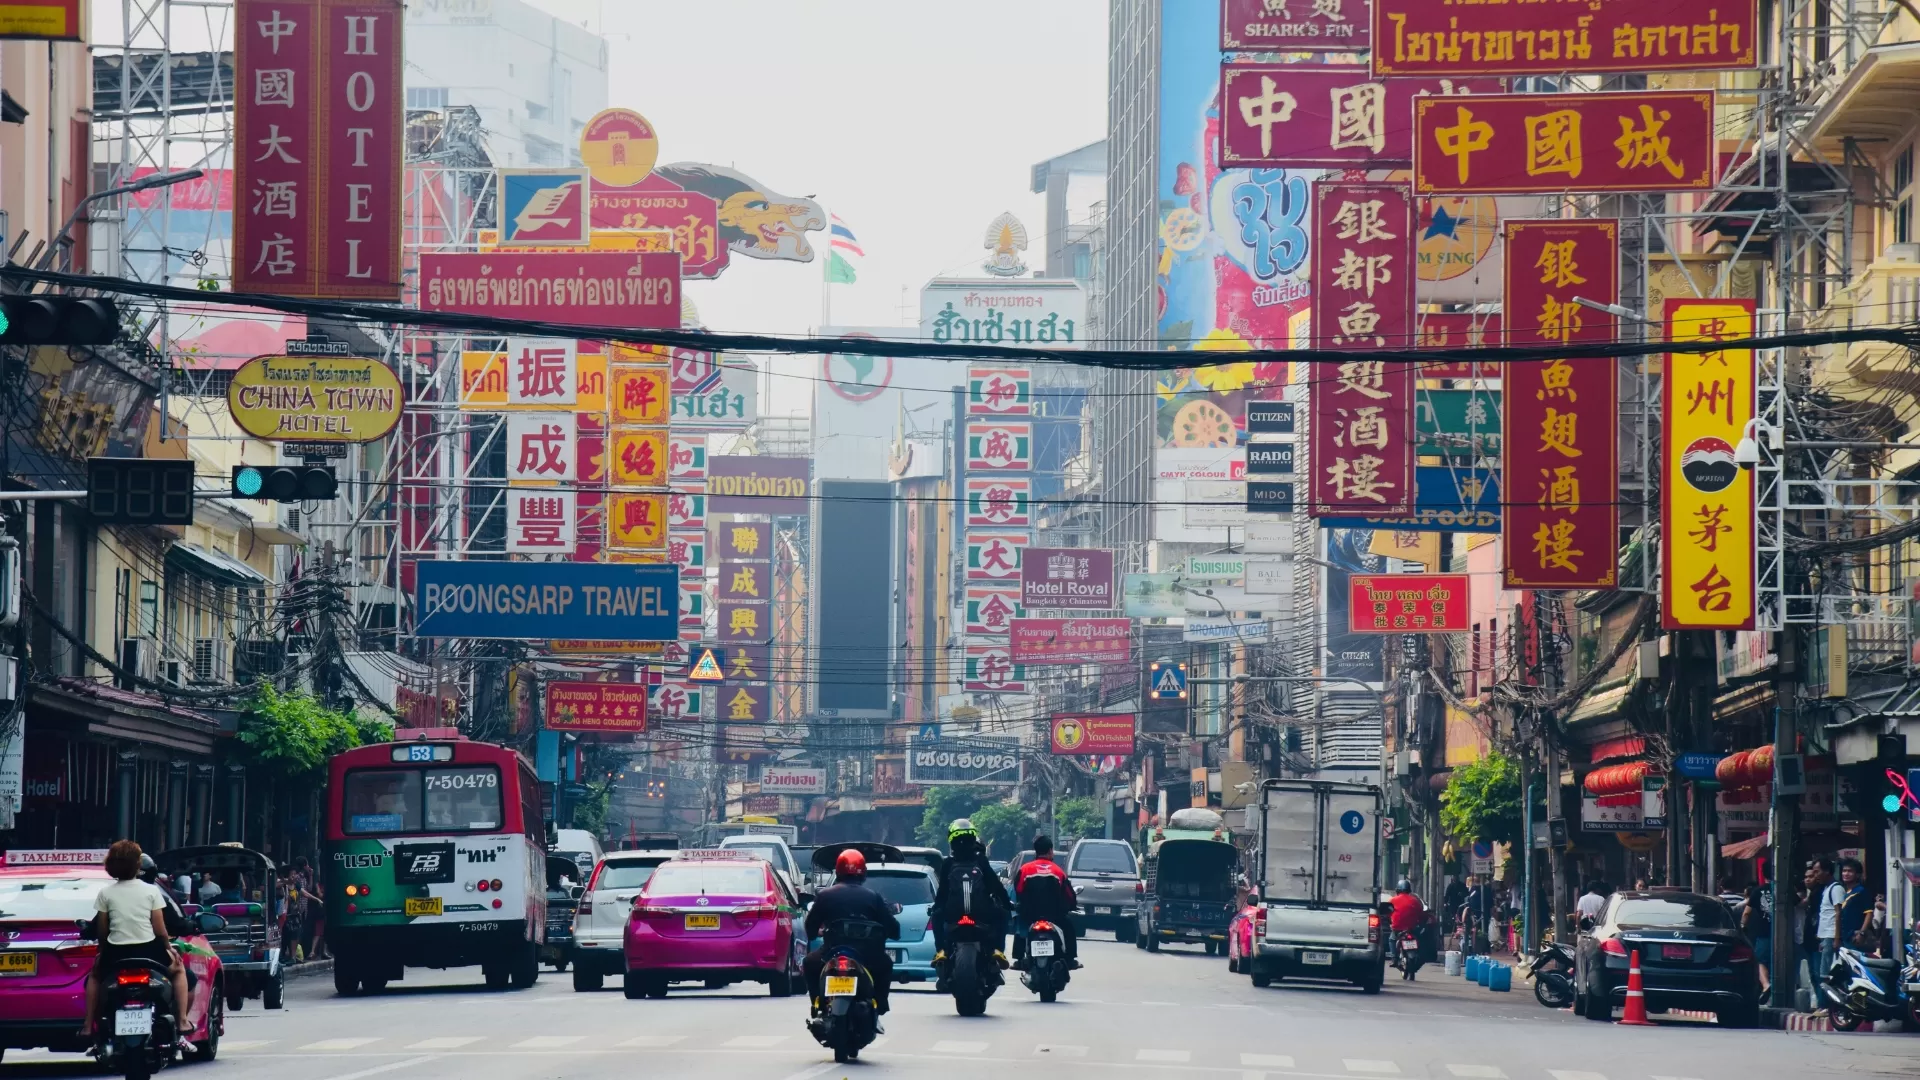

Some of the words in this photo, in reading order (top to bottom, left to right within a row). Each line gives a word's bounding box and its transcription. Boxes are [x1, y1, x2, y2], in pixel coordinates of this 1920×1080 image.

[1245, 22, 1319, 37] SHARK'S
[1325, 24, 1354, 37] FIN
[1388, 11, 1593, 63] ไชน่าทาวน์
[1612, 9, 1740, 58] สกาล่า
[252, 10, 301, 276] 中國大酒店
[344, 15, 378, 278] HOTEL
[1435, 104, 1685, 184] 中國城
[1418, 252, 1431, 264] M
[1437, 252, 1475, 264] SING
[963, 292, 1043, 308] ห้างขายทอง
[238, 384, 316, 411] CHINA
[323, 387, 394, 413] TOWN
[671, 387, 745, 418] งเฮง
[1532, 240, 1588, 574] 銀都魚翅酒樓
[278, 413, 353, 434] HOTEL
[1249, 411, 1292, 423] CITIZEN
[516, 347, 567, 548] 振成豐
[1250, 452, 1292, 461] RADO
[1254, 490, 1286, 500] MIDO
[979, 376, 1017, 686] 和成興大金行
[1190, 558, 1244, 574] โรงแรมบร
[1258, 570, 1282, 578] BALL
[1026, 581, 1062, 594] Hotel
[1068, 582, 1108, 596] Royal
[425, 583, 574, 616] ROONGSARP
[582, 586, 669, 617] TRAVEL
[1026, 597, 1058, 606] Bangkok
[1069, 598, 1108, 606] Chinatown
[1373, 615, 1446, 628] 批发干果
[1189, 623, 1241, 637] BROADWAY
[1244, 623, 1268, 637] HOTE
[727, 527, 760, 760] 聯成興大金
[1341, 651, 1370, 660] CITIZEN
[603, 718, 642, 727] GOLDSMITH
[1105, 734, 1132, 742] Fishball
[411, 747, 431, 760] 53
[26, 777, 60, 796] Hotel
[425, 773, 497, 790] 7-50479
[1352, 816, 1359, 829] 9
[1601, 812, 1636, 821] 魚翅酒
[21, 853, 93, 862] TAXI-METER
[691, 850, 738, 858] TAXI-METER
[1338, 853, 1352, 863] A9
[411, 855, 441, 868] FB
[1893, 859, 1900, 870] 4
[408, 901, 439, 911] 12-0771
[702, 915, 718, 924] 1775
[459, 922, 498, 932] 7-50479
[9, 955, 33, 966] 6696
[121, 1026, 146, 1034] 6472
